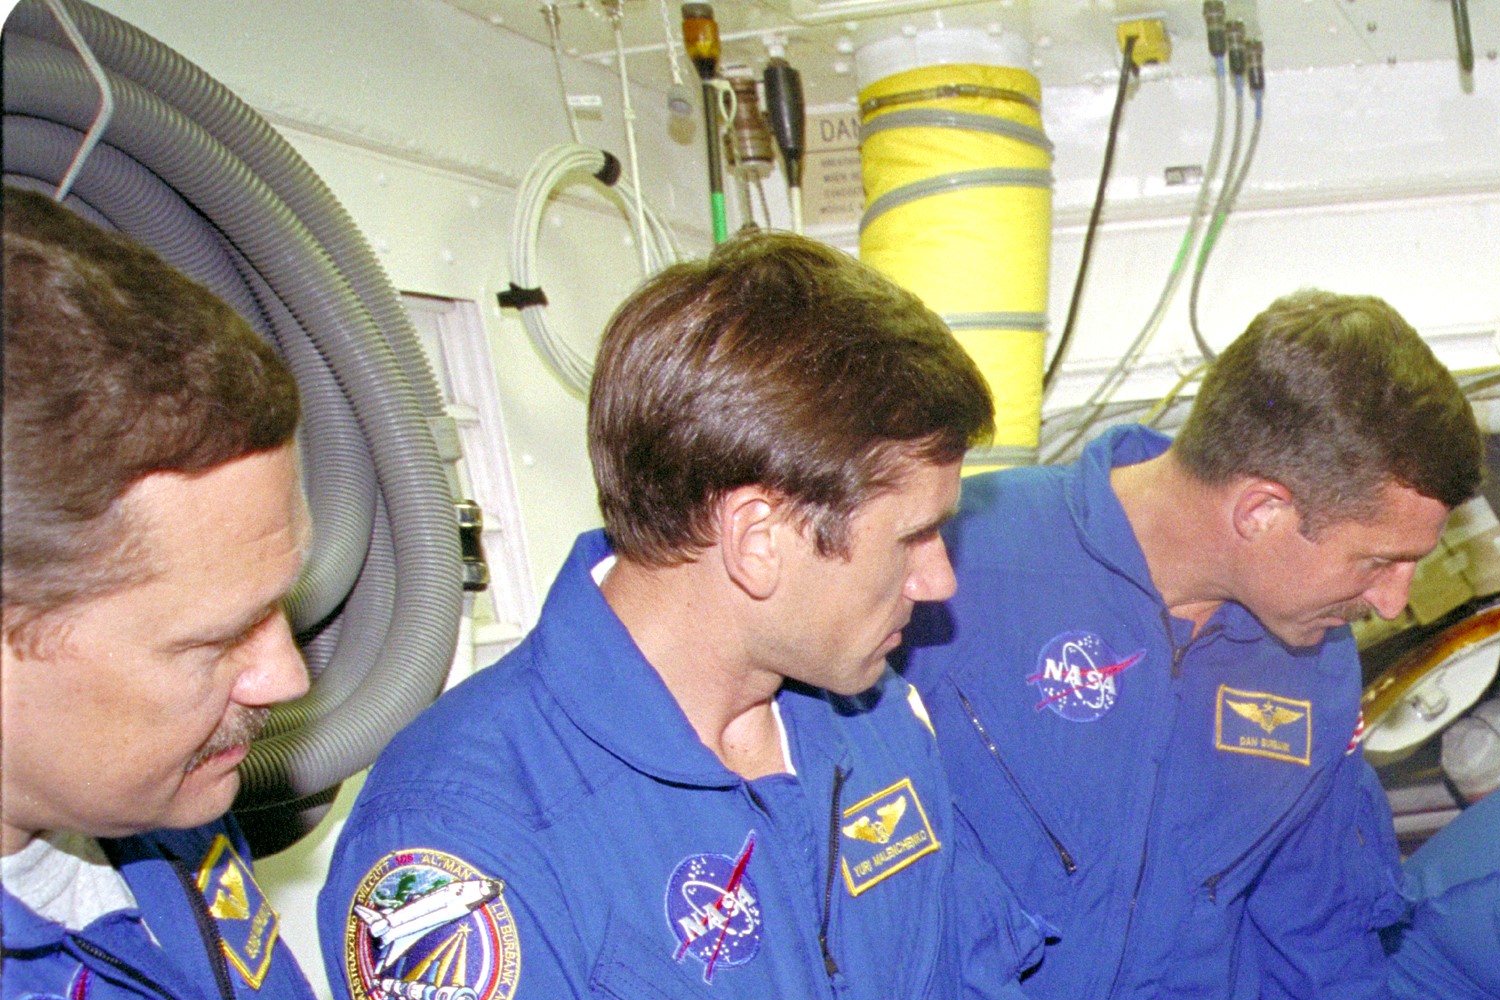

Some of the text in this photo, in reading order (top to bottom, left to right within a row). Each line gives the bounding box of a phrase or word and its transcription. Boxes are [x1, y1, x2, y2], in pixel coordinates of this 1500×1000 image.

[1043, 658, 1118, 696] NASA
[420, 853, 473, 881] ALTMAN
[853, 829, 927, 878] YURI MALENCHENKO
[678, 881, 756, 941] NASA
[499, 921, 517, 986] BURBANK
